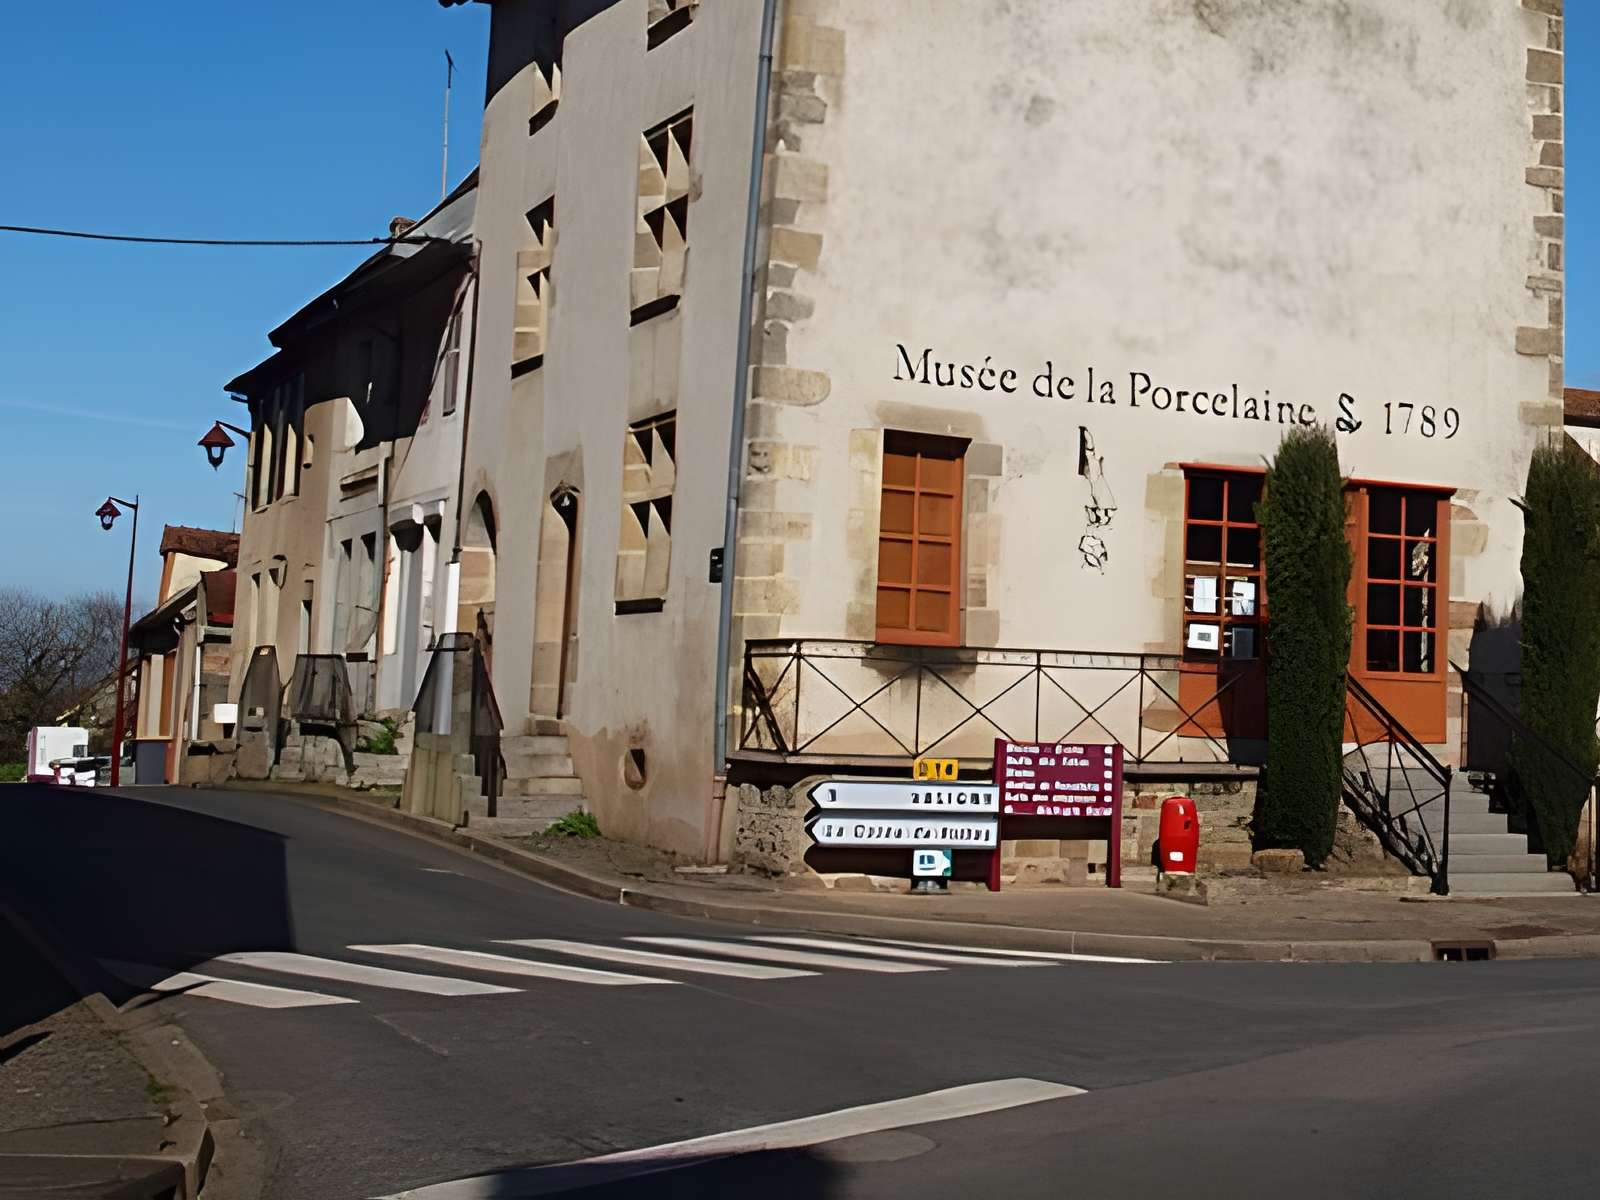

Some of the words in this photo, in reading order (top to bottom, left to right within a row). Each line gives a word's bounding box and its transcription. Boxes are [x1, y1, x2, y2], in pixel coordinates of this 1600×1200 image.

[893, 344, 1018, 394] Musée
[1032, 360, 1076, 400] de
[1086, 367, 1117, 405] la
[1129, 371, 1317, 426] Porcelaine
[1384, 401, 1461, 440] 1789
